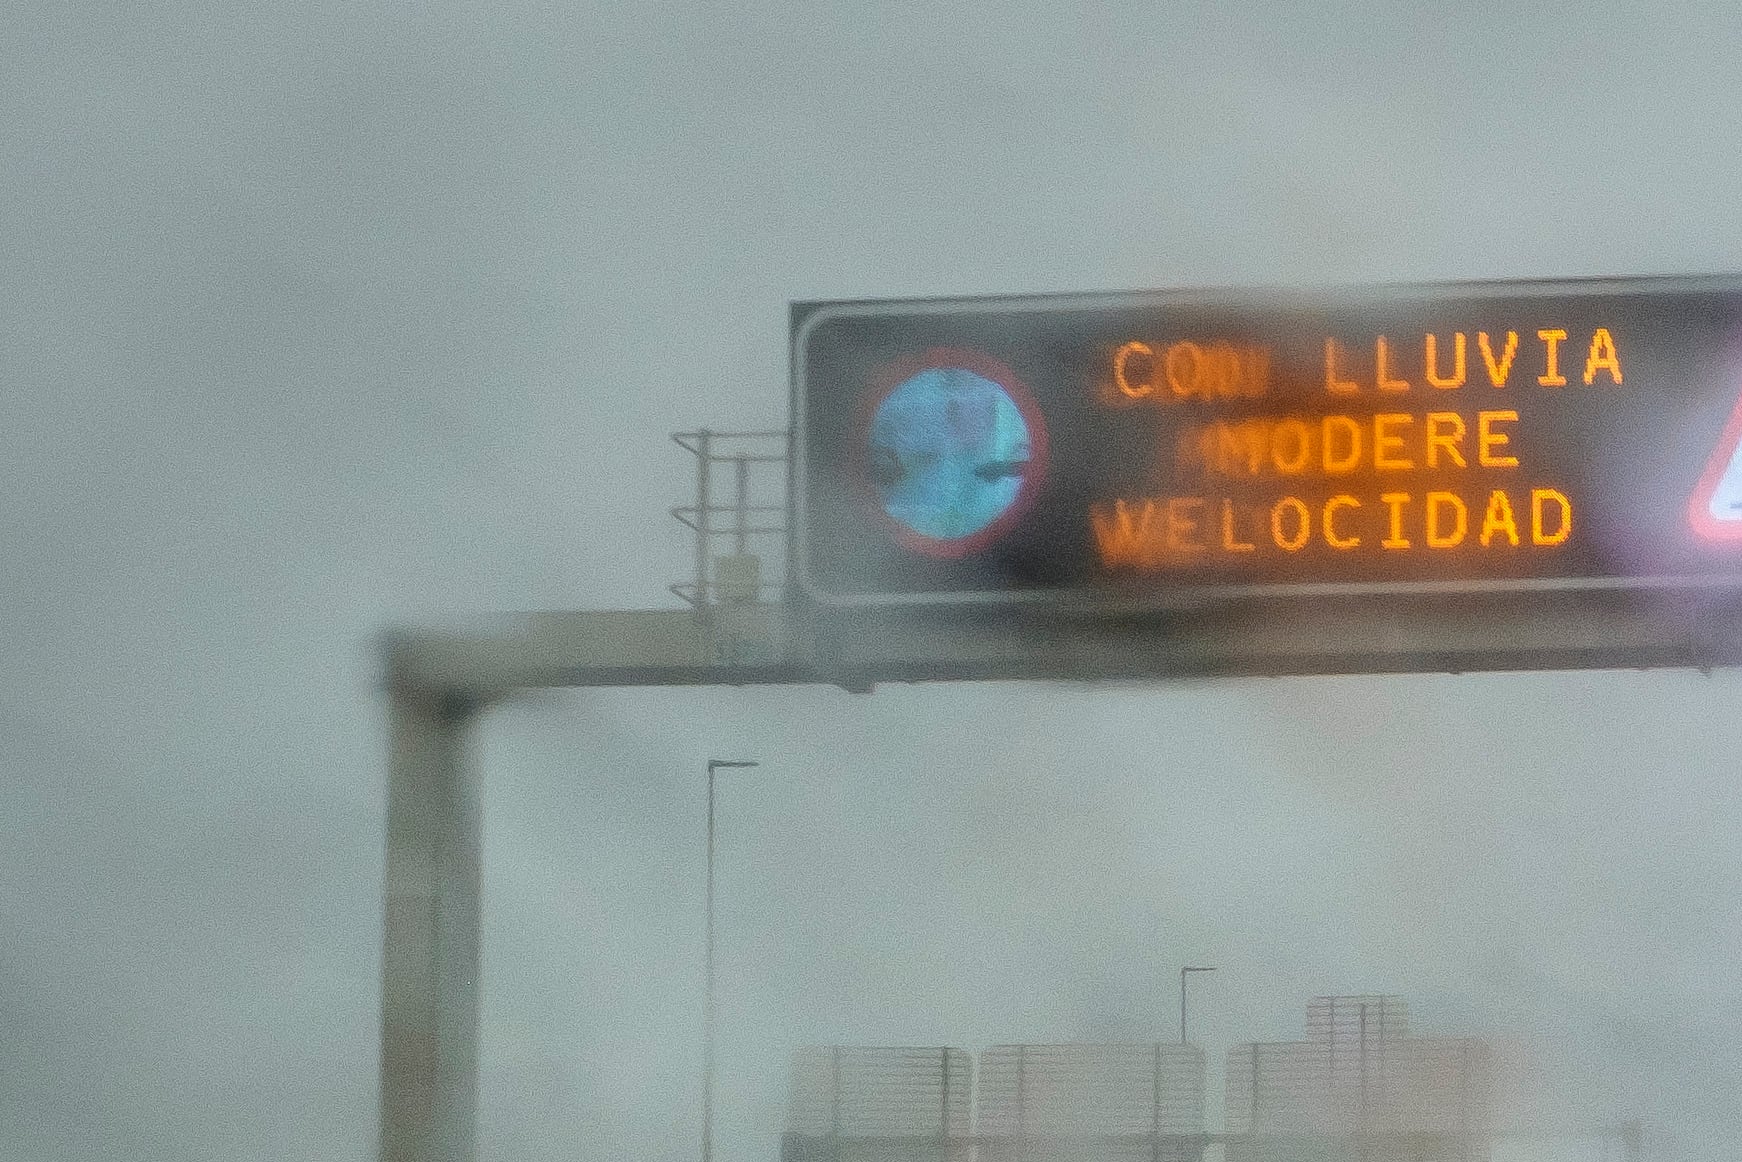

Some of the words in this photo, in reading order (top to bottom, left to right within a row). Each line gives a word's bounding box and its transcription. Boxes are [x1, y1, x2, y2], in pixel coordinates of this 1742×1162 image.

[1113, 339, 1263, 399] CO
[1323, 327, 1625, 394] LLUVIA
[1211, 409, 1520, 476] MODERE
